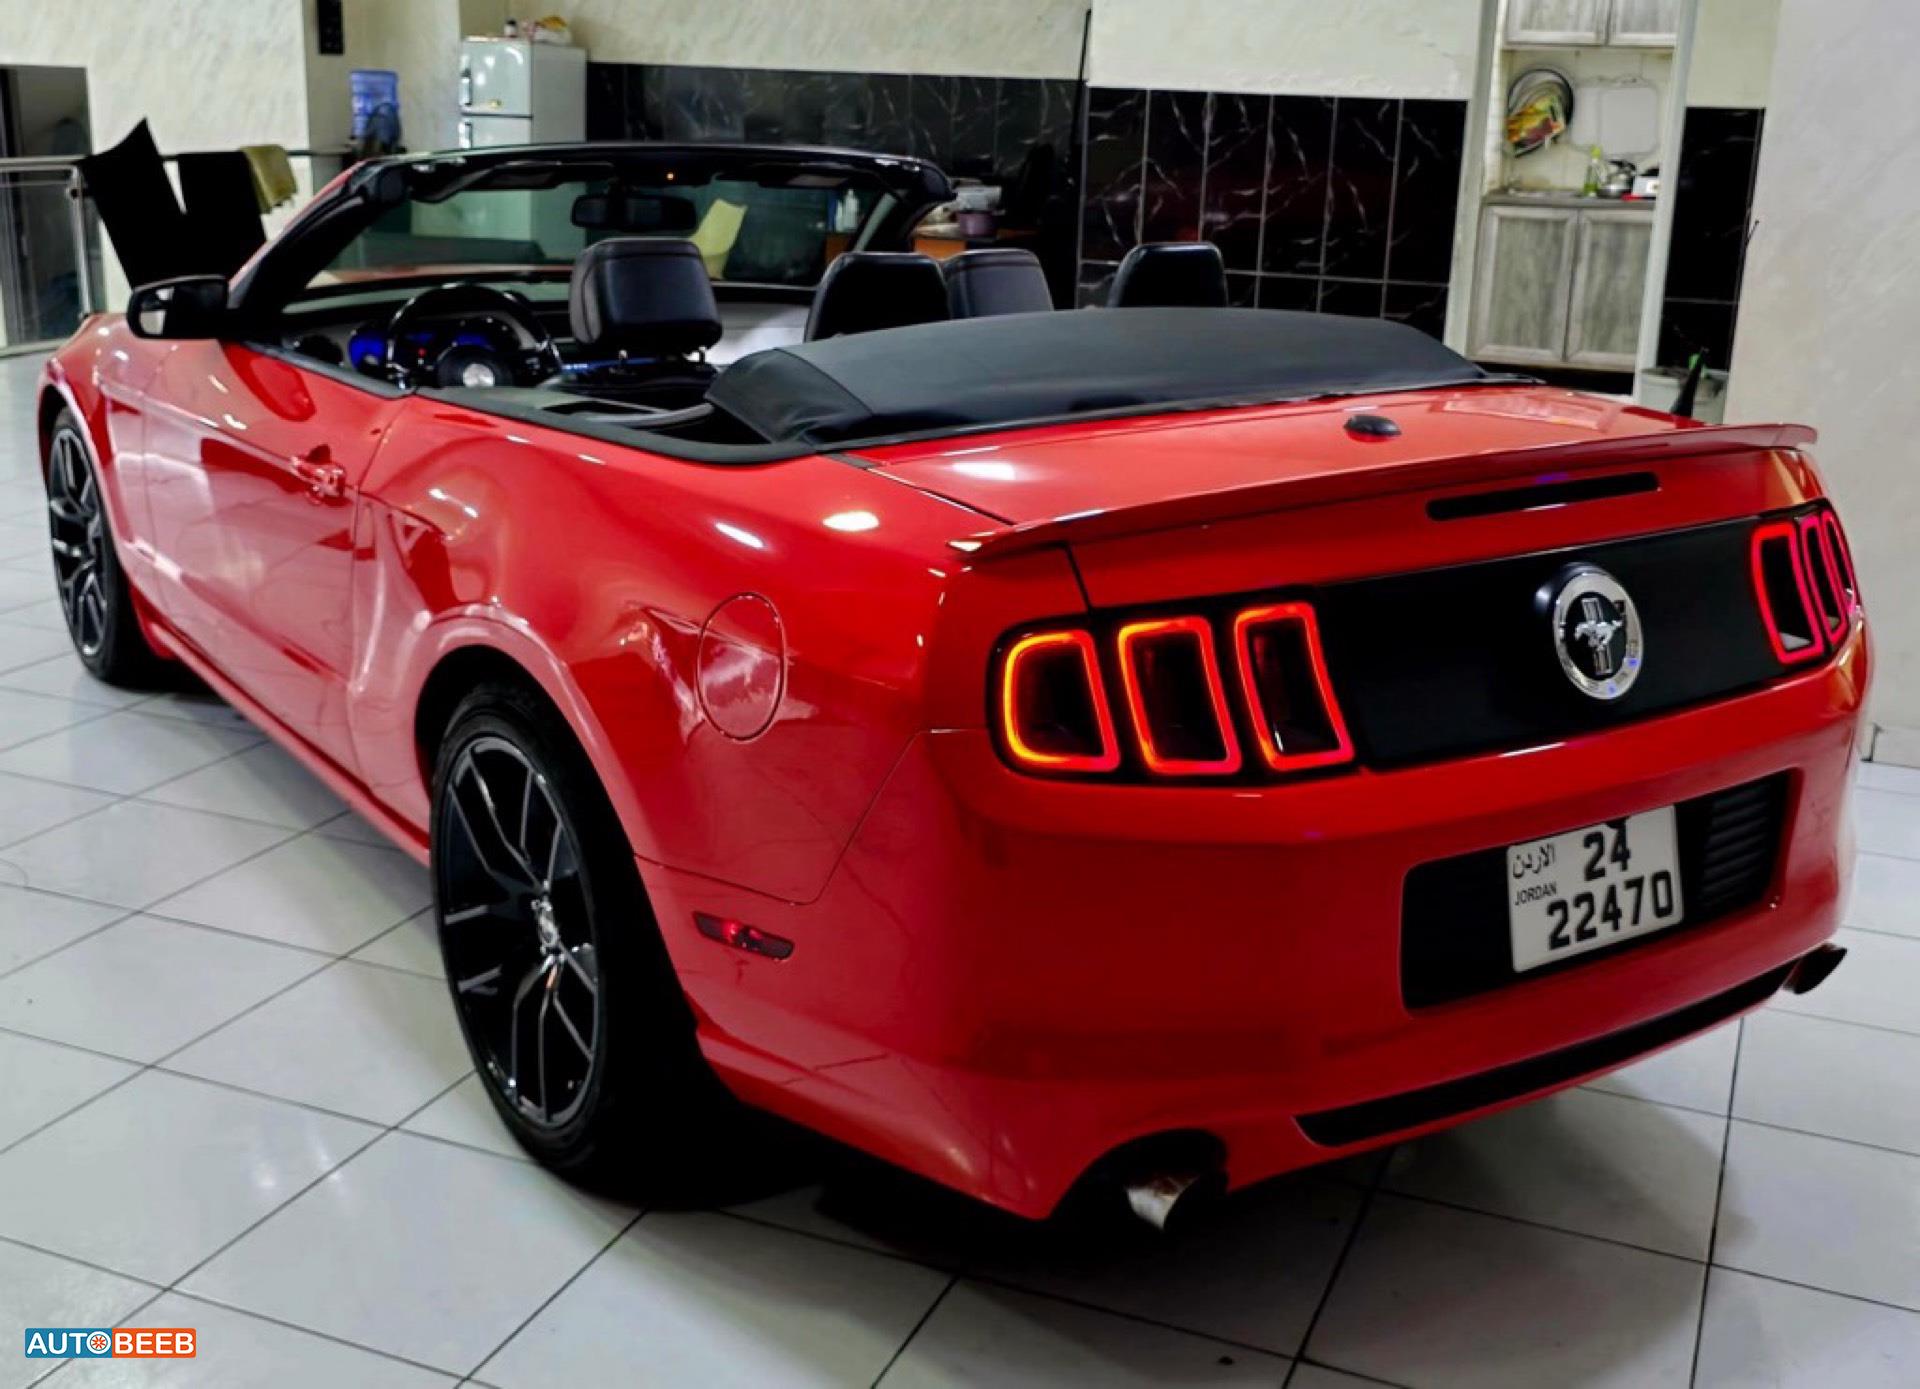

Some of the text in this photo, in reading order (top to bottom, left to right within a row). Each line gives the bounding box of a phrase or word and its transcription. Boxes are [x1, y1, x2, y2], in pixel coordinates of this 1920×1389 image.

[1584, 818, 1630, 882] 24
[1514, 882, 1557, 906] JORDAN
[1547, 869, 1673, 950] 22470
